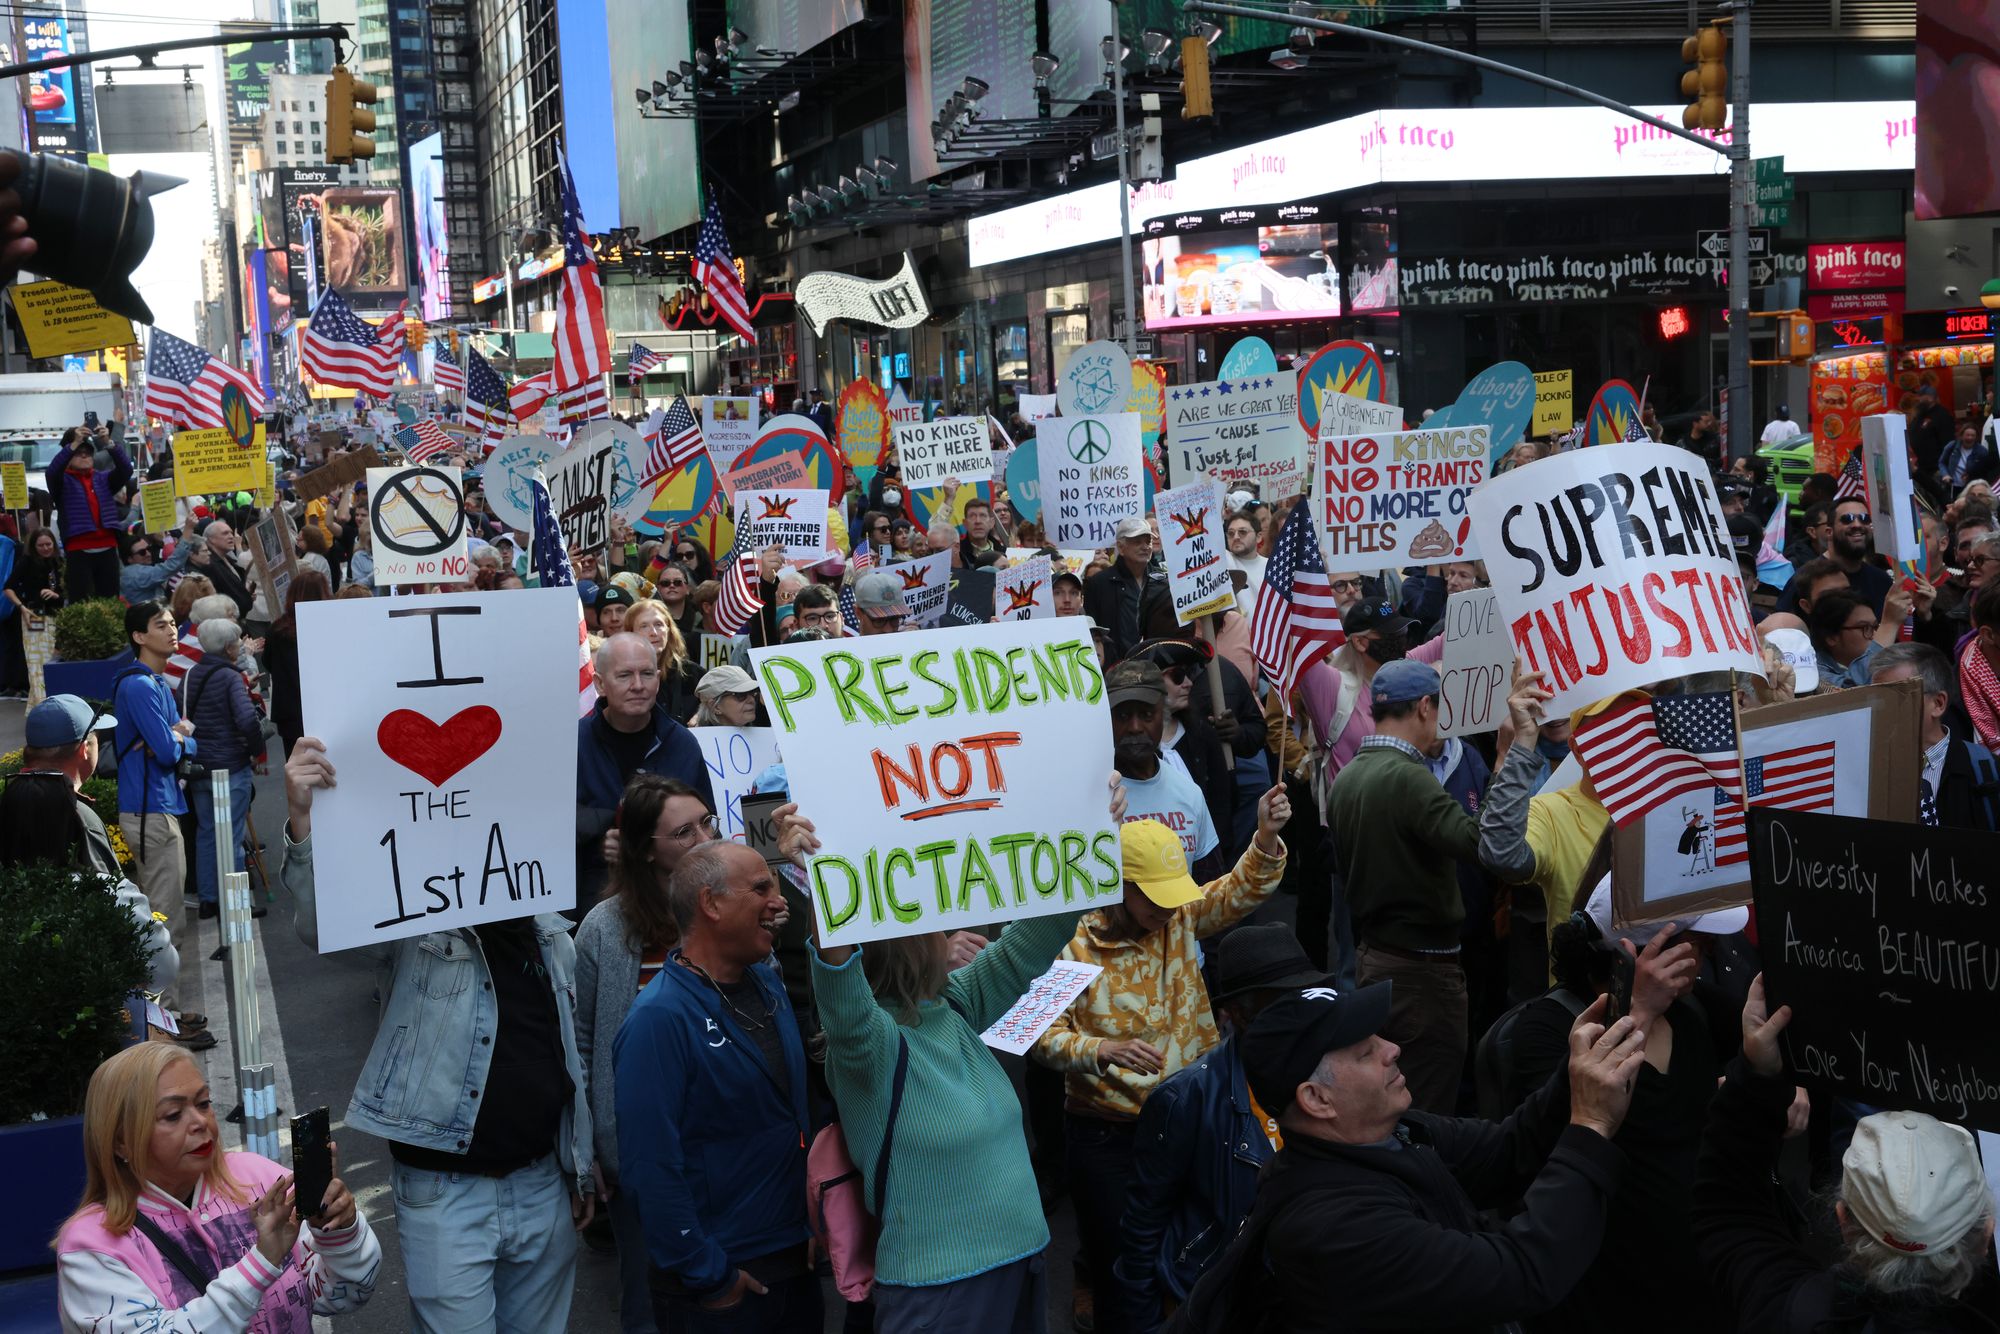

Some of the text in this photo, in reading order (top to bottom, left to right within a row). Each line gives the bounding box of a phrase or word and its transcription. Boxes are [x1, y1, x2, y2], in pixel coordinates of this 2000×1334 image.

[1399, 122, 1454, 150] taco
[1762, 161, 1768, 177] 7
[1756, 182, 1783, 200] Fashion
[1758, 210, 1766, 223] W
[1769, 208, 1778, 224] 41
[1708, 239, 1759, 251] ONE AY
[1609, 251, 1657, 293] pink
[1664, 252, 1707, 276] taco
[1775, 253, 1807, 273] aco
[1815, 245, 1902, 282] pink taco
[1401, 258, 1451, 297] pink
[1458, 258, 1503, 283] taco
[1506, 255, 1555, 296] pink
[1562, 256, 1606, 280] taco
[20, 283, 69, 298] Freedom of
[51, 296, 68, 306] just
[70, 291, 95, 301] impo
[43, 319, 50, 327] it
[44, 308, 52, 316] to
[1069, 355, 1113, 381] MELT ICE
[1534, 372, 1569, 384] RULE OF
[1469, 376, 1530, 409] Liberty
[1536, 390, 1571, 402] FUCKING
[889, 407, 920, 421] NITE
[1177, 406, 1210, 424] ARE
[1218, 403, 1237, 417] WE
[1241, 399, 1273, 415] GREAT
[1336, 395, 1393, 427] GOVERNMENT
[1481, 400, 1498, 419] 4
[1541, 412, 1562, 422] LAW
[708, 433, 751, 441] AGGRESSION
[901, 422, 977, 444] NO KINGS
[1215, 423, 1260, 440] 'CAUSE
[1322, 418, 1335, 437] of
[195, 439, 235, 448] JOURNALI
[904, 437, 983, 461] NOT HERE
[1325, 438, 1379, 466] NO
[1393, 429, 1487, 461] KINGS
[207, 462, 251, 472] DEMOCRACY
[499, 447, 531, 467] MELT
[906, 463, 932, 481] NOT
[937, 464, 947, 476] IN
[950, 456, 992, 474] AMERICA
[1183, 444, 1257, 472] I just feel
[1208, 456, 1296, 481] Embarrassed
[561, 446, 613, 508] MUST
[732, 461, 793, 488] IMMIGRANTS
[753, 468, 803, 490] NEW YORK!
[1059, 465, 1129, 483] NO KINGS
[1325, 460, 1483, 494] NO TYRANTS
[1060, 483, 1137, 502] NO FASCISTS
[1061, 501, 1138, 518] NO TYRANTS
[1326, 490, 1441, 525] NO MORE
[753, 523, 821, 533] HAVE FRIENDS
[1058, 523, 1084, 542] NO
[1326, 522, 1396, 555] THIS
[1501, 466, 1732, 594] SUPREME
[1192, 536, 1204, 553] NO
[387, 562, 435, 575] NO NO
[1185, 550, 1213, 571] KINGS
[1196, 570, 1212, 588] NO
[917, 583, 946, 600] FRIENDS
[1017, 608, 1031, 620] NO
[1447, 596, 1496, 643] LOVE
[1511, 568, 1762, 698] INJUSTIC
[389, 606, 484, 688] I
[760, 639, 1104, 733] PRESIDENTS
[1439, 664, 1503, 732] STOP
[870, 731, 1023, 811] NOT
[400, 790, 471, 822] THE
[374, 822, 552, 929] 1st Am.
[1770, 820, 1987, 918] Diversity Makes
[807, 830, 1122, 938] DICTATORS
[1785, 912, 2000, 991] America BEAUTIFU
[1046, 969, 1073, 985] We
[996, 1000, 1040, 1039] People
[1014, 973, 1092, 1044] We the People
[1785, 1028, 2000, 1119] Love Your Neighbo
